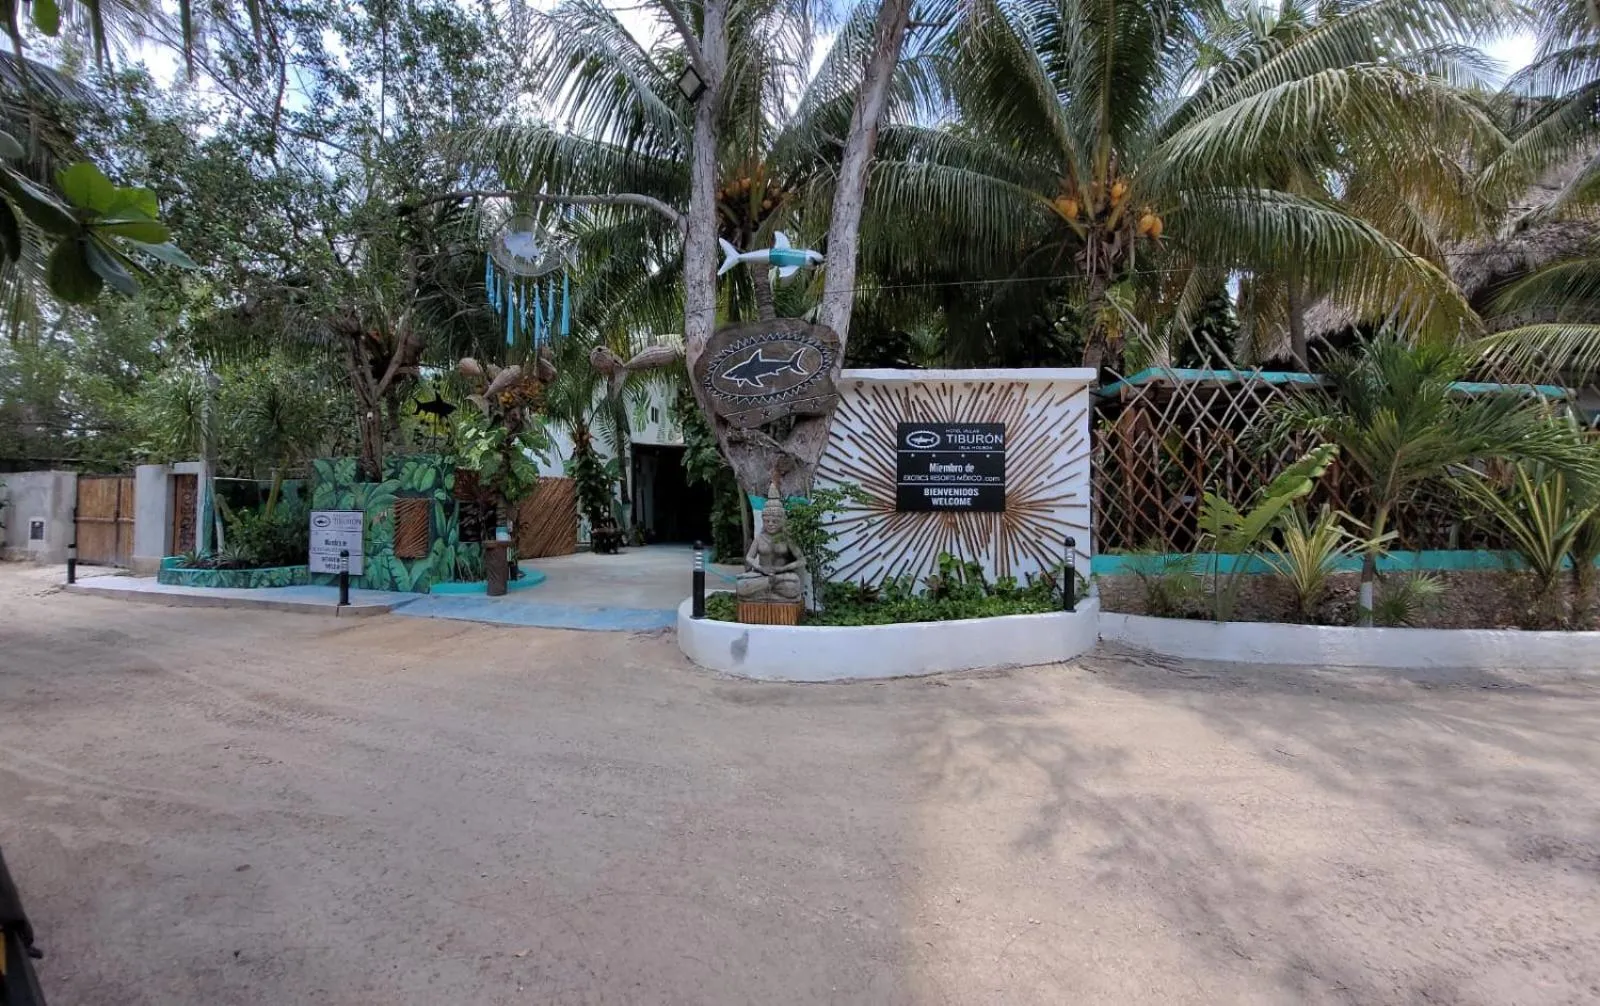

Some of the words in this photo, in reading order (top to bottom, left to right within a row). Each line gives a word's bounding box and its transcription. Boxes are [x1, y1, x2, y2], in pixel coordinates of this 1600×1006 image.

[946, 433, 1003, 444] TIBURÓN
[929, 462, 963, 472] Miembro
[965, 463, 975, 472] de
[924, 488, 979, 496] BIENVENIDOS
[931, 498, 972, 506] WELCOME
